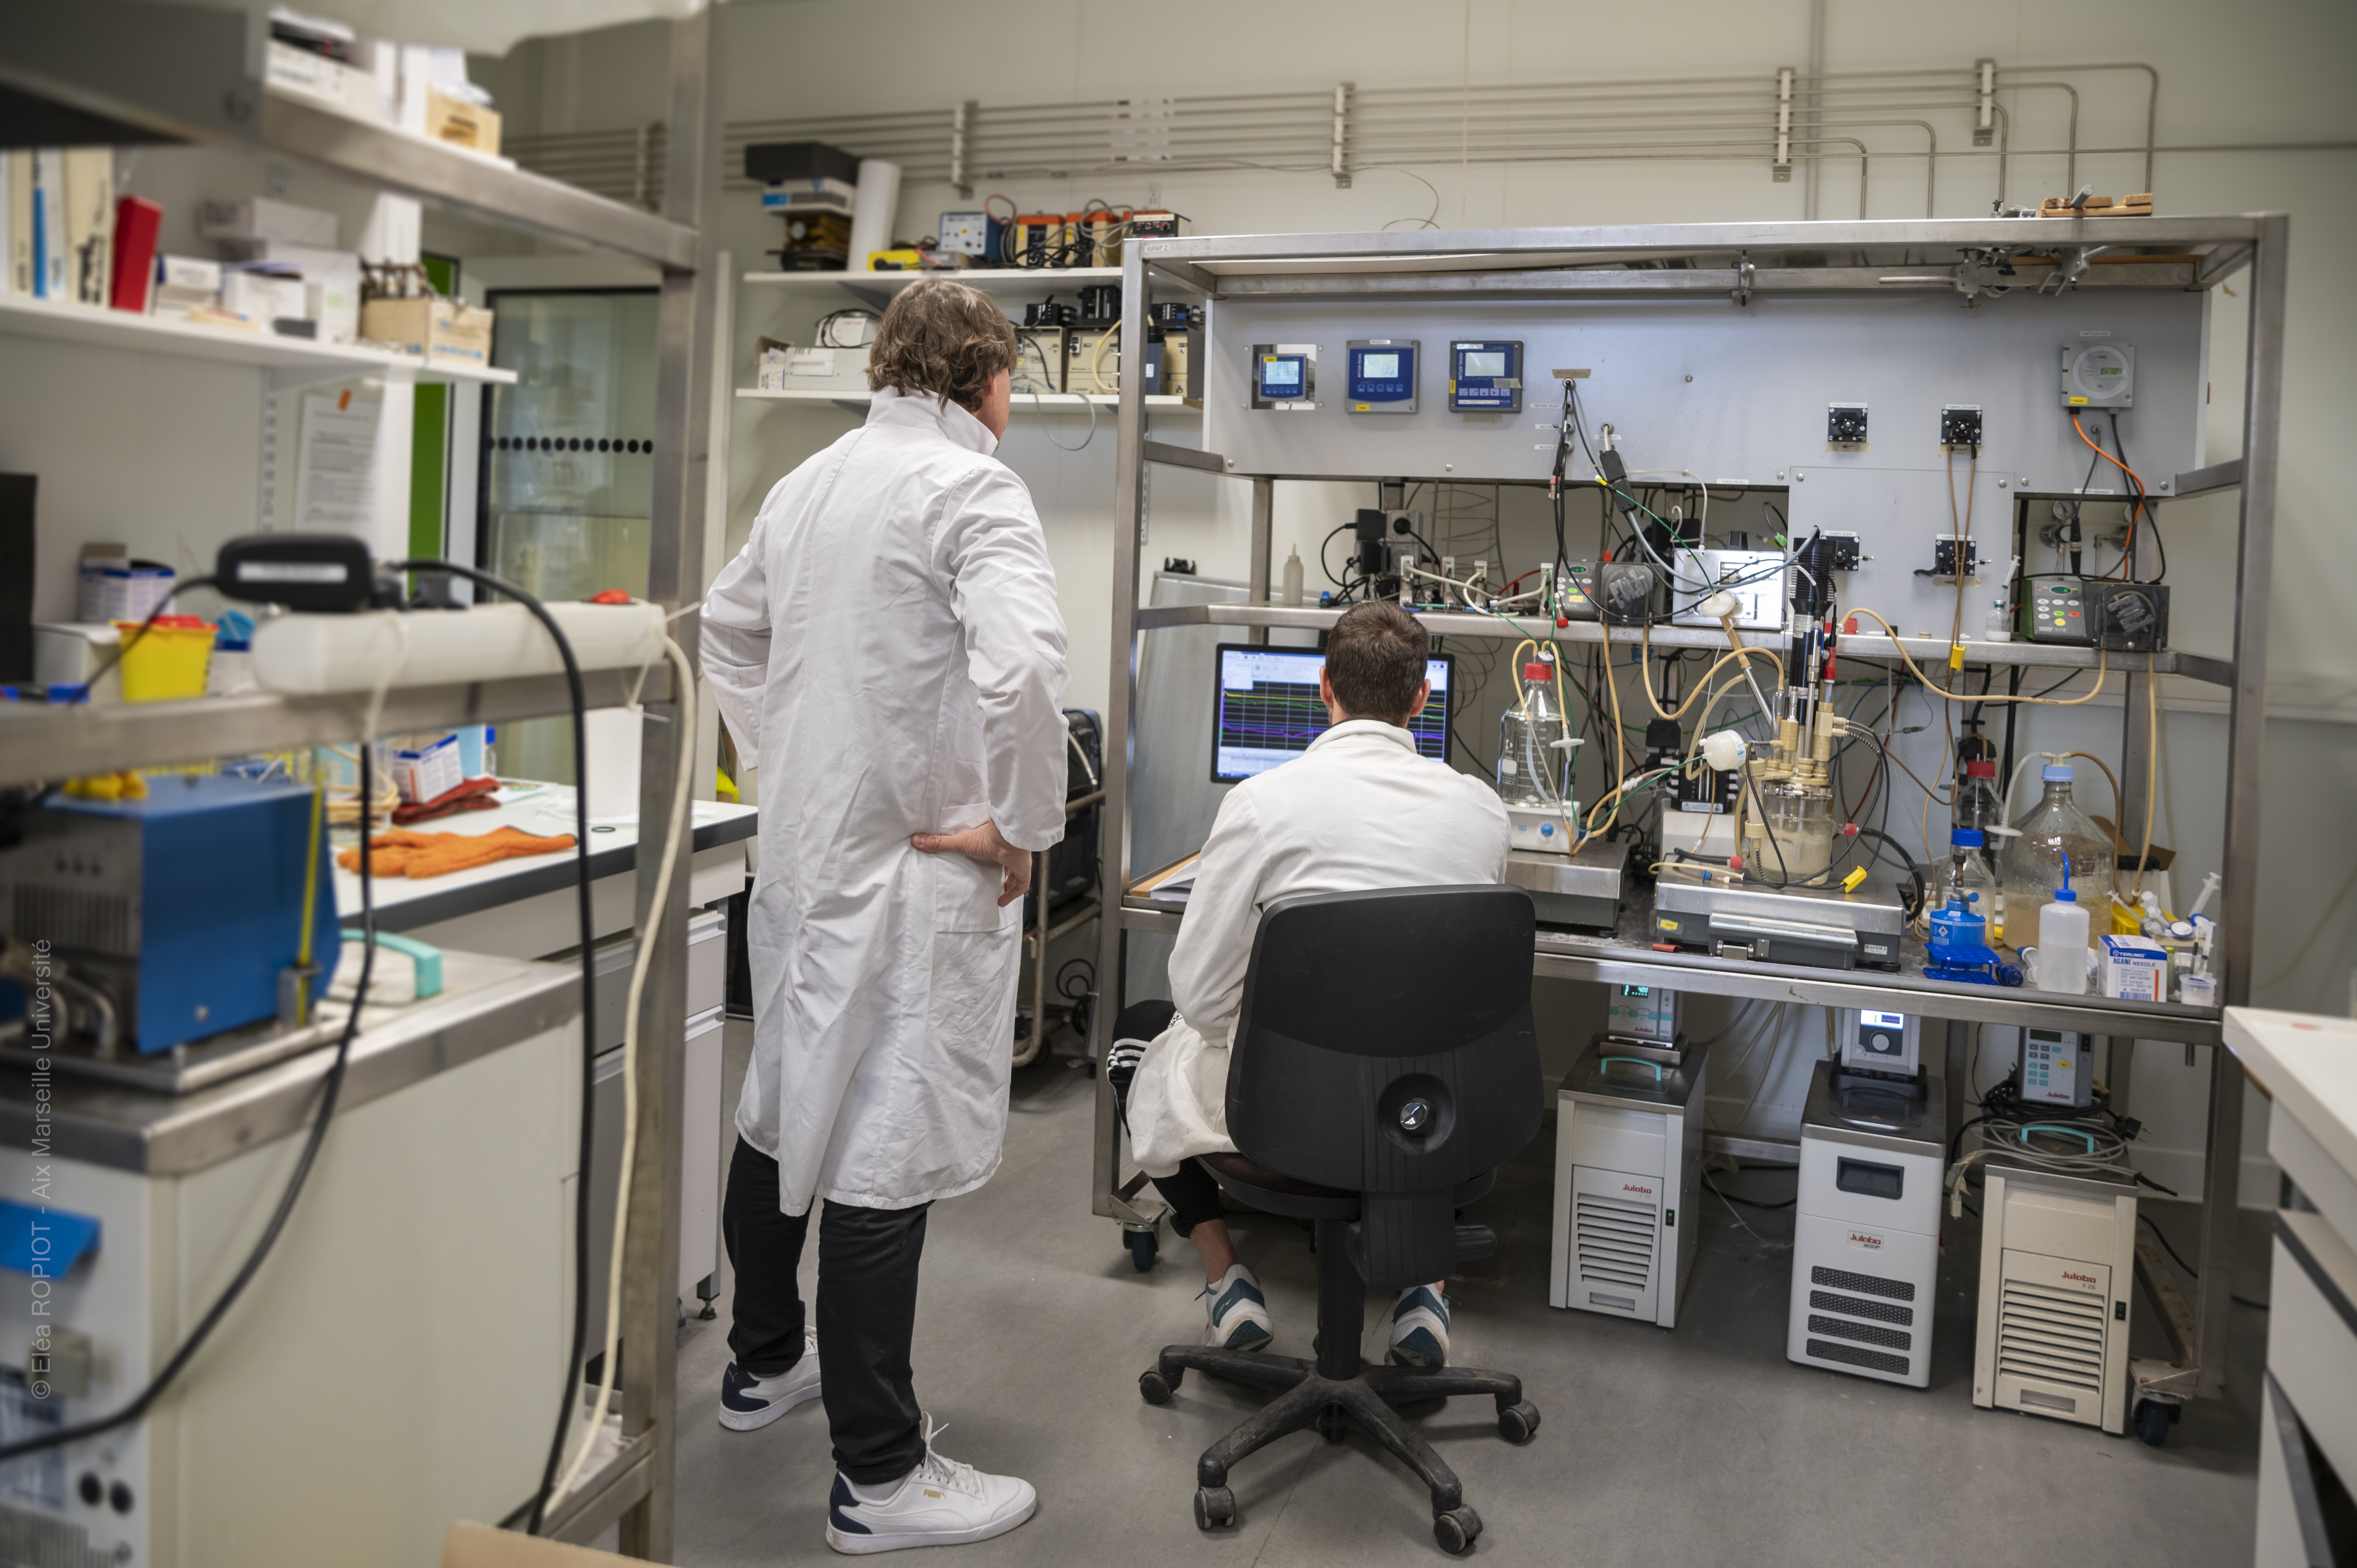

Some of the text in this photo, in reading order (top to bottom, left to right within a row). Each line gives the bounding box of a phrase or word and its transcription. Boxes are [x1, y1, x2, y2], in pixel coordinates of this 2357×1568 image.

[1623, 1184, 1652, 1194] Julabo
[1850, 1233, 1881, 1244] Julabo
[2061, 1271, 2096, 1283] Julabo
[924, 1488, 941, 1499] PUMA
